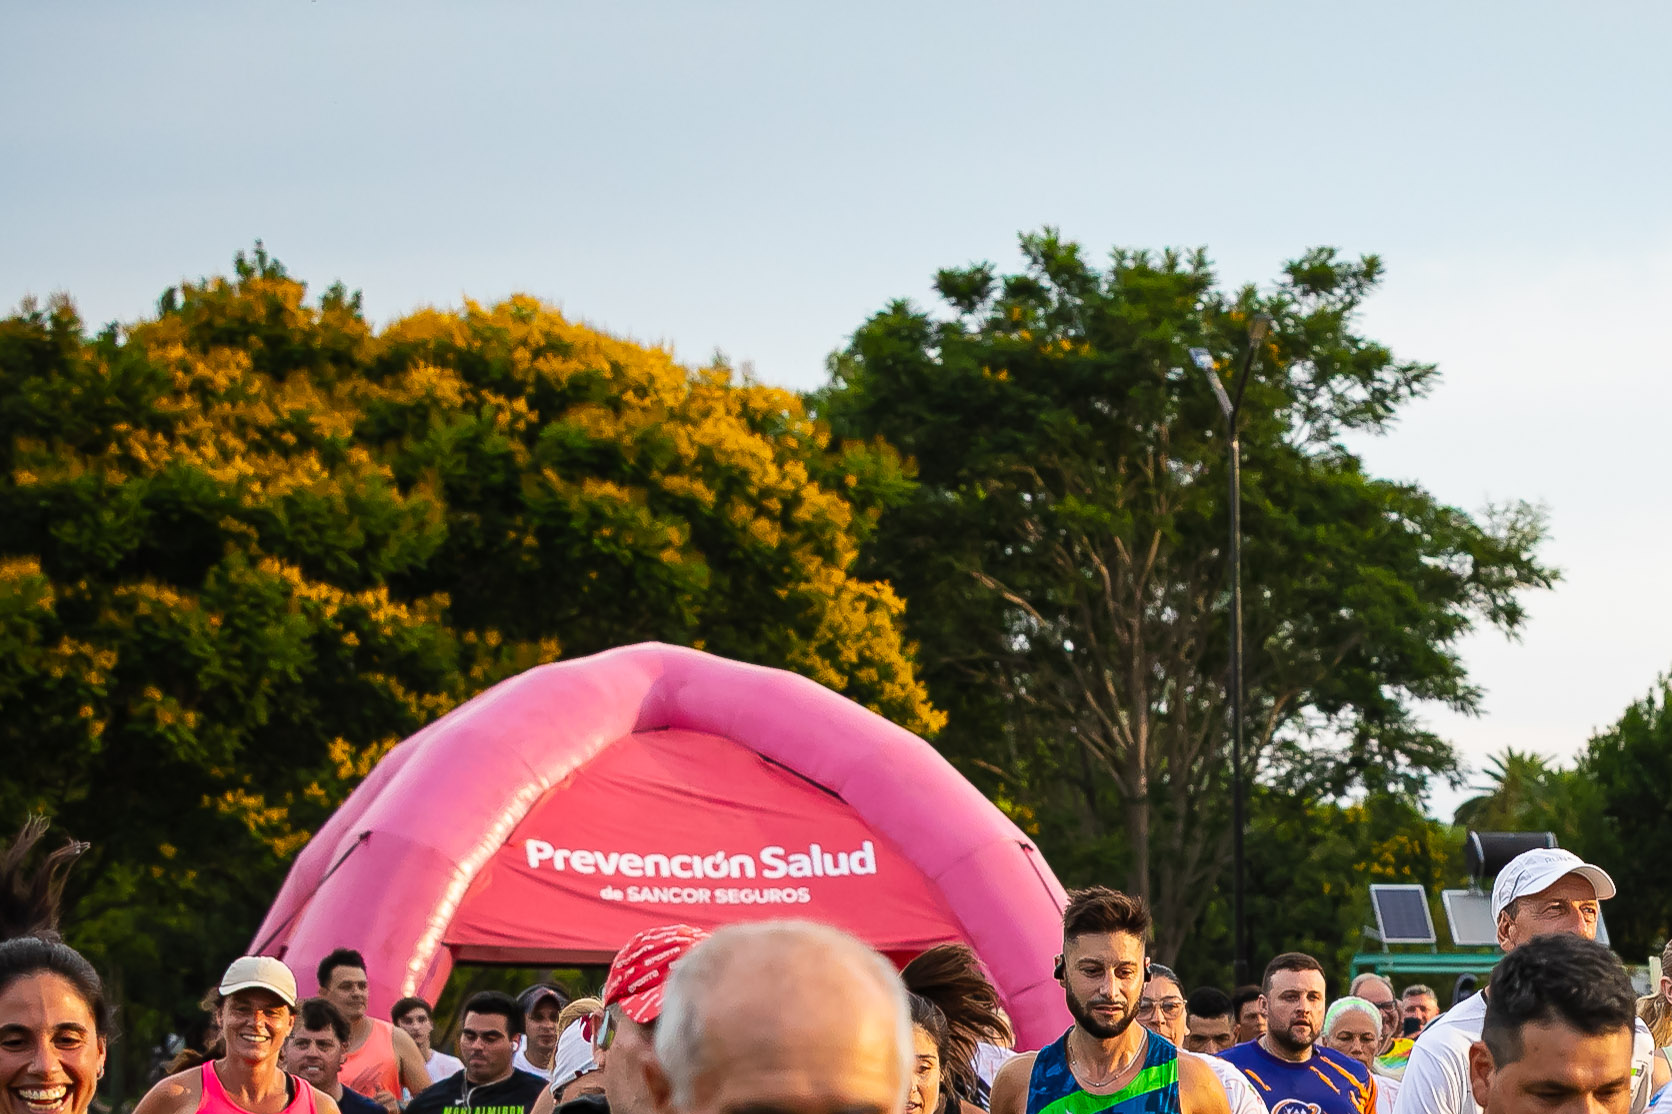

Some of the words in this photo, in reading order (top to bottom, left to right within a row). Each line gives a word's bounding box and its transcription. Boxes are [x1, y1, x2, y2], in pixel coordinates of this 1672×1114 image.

[525, 838, 757, 879] Prevención
[760, 840, 878, 879] Salud
[600, 886, 624, 901] de
[627, 886, 711, 903] SANCOR
[714, 887, 811, 904] SEGUROS
